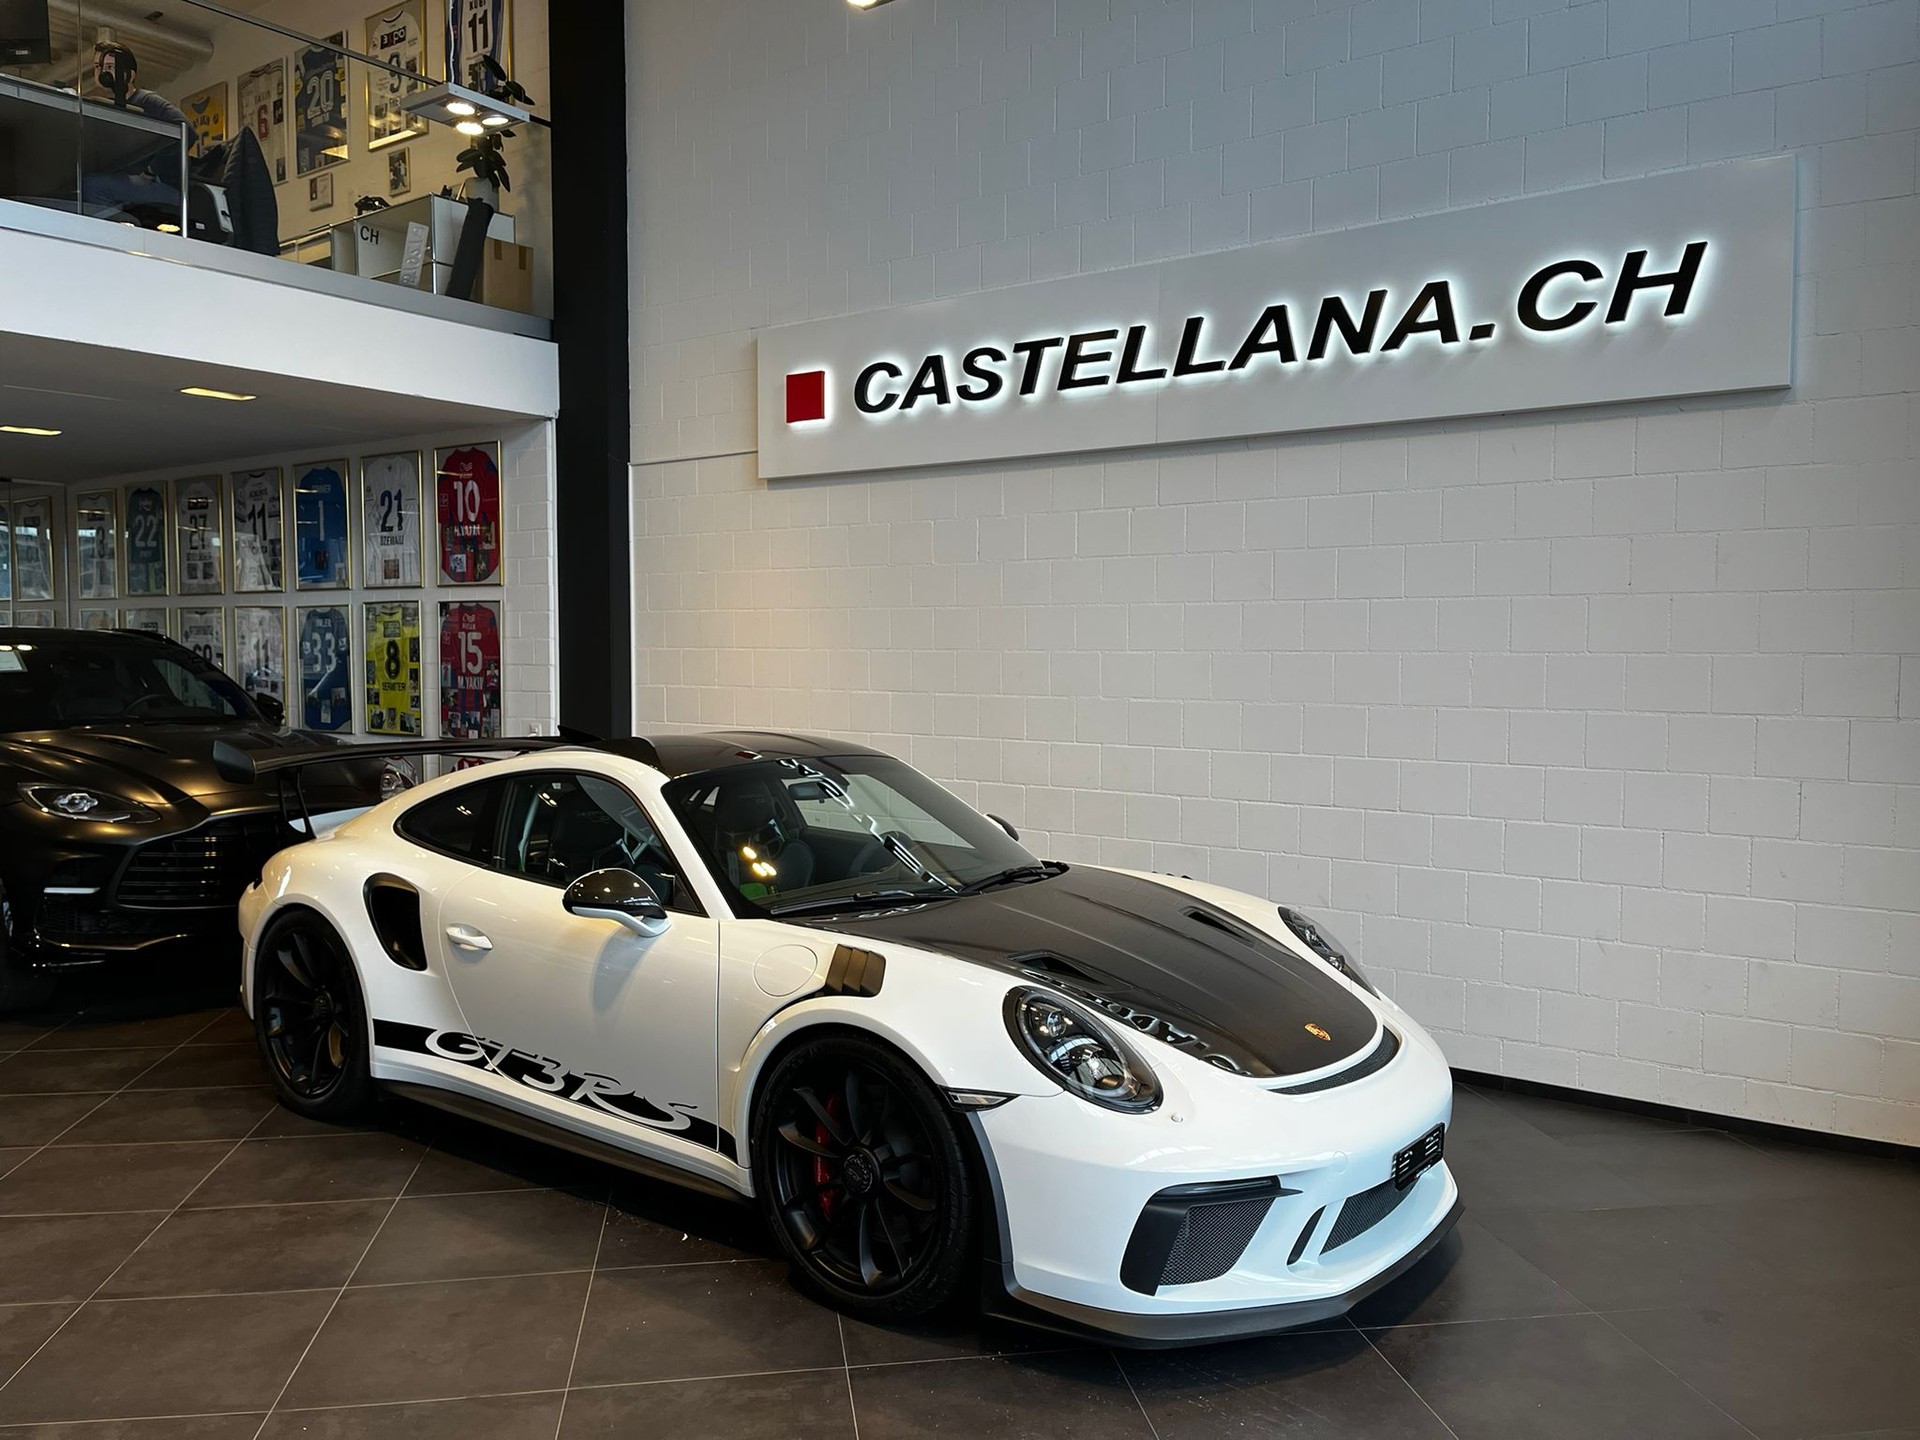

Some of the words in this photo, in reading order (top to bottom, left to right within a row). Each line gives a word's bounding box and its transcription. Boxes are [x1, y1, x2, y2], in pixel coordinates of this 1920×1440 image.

[468, 9, 489, 53] 11
[388, 52, 402, 93] 9
[306, 70, 334, 119] 20
[257, 104, 269, 139] 6
[360, 226, 379, 245] CH
[854, 241, 1708, 413] CASTELLANA.CH
[318, 500, 325, 541] 1
[380, 489, 404, 533] 21
[453, 480, 481, 522] 10
[134, 515, 157, 547] 22
[189, 514, 207, 550] 27
[247, 503, 267, 541] 11
[311, 632, 337, 673] 33
[384, 639, 400, 680] 8
[458, 631, 483, 675] 15
